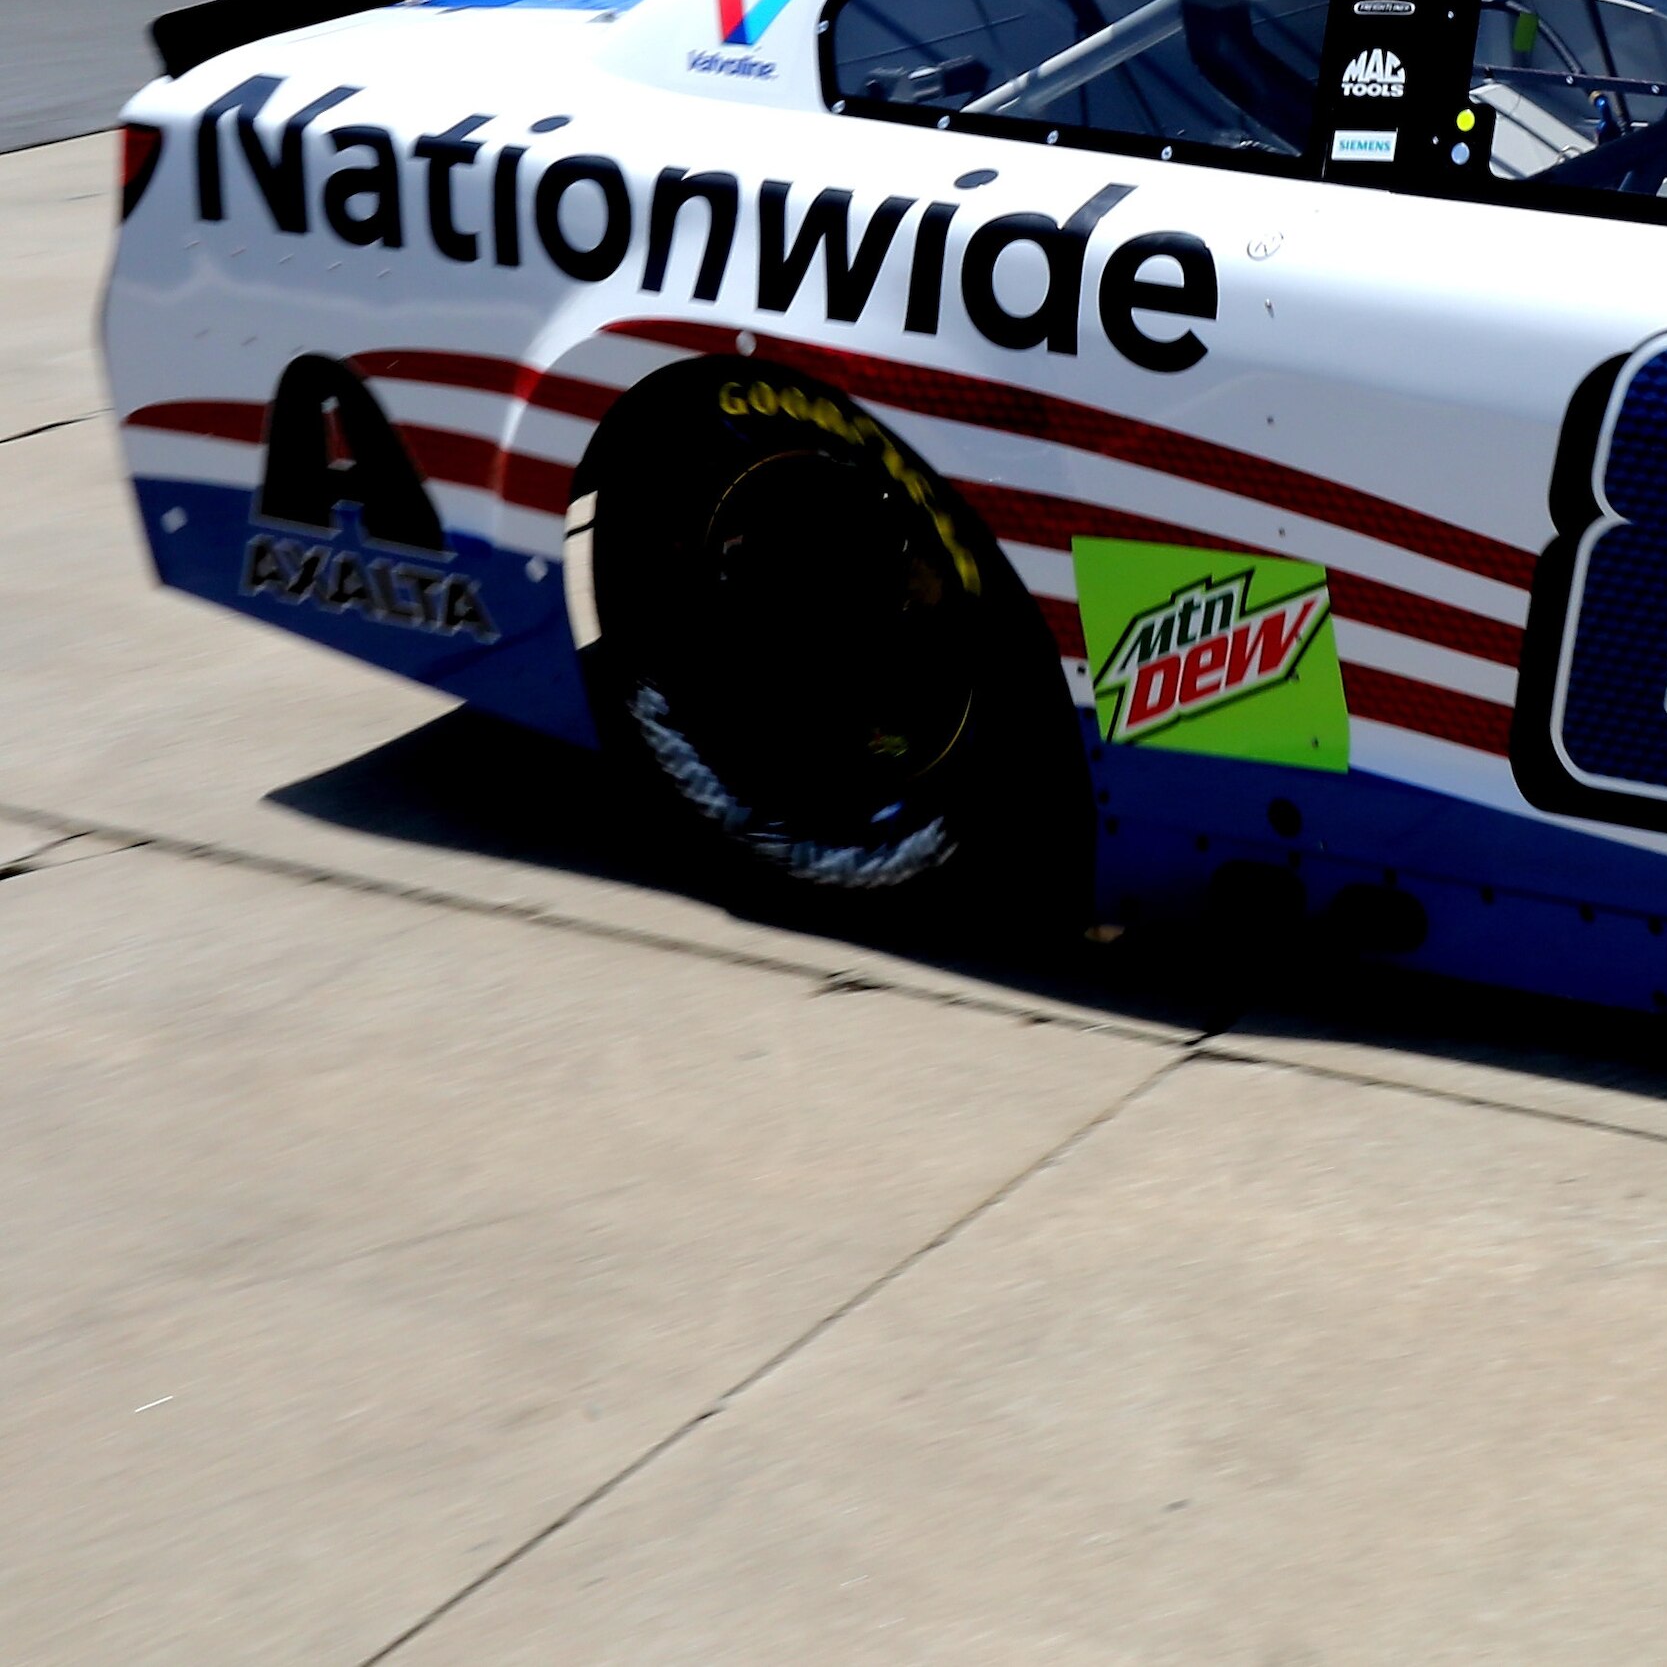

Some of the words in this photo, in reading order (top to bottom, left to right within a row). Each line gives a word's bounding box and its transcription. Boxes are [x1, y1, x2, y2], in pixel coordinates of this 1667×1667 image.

[1342, 48, 1406, 84] MAC
[1341, 83, 1404, 97] TOOLS
[1339, 140, 1391, 151] SIEMENS
[197, 73, 1219, 373] Nationwide
[240, 533, 500, 645] AXALTA
